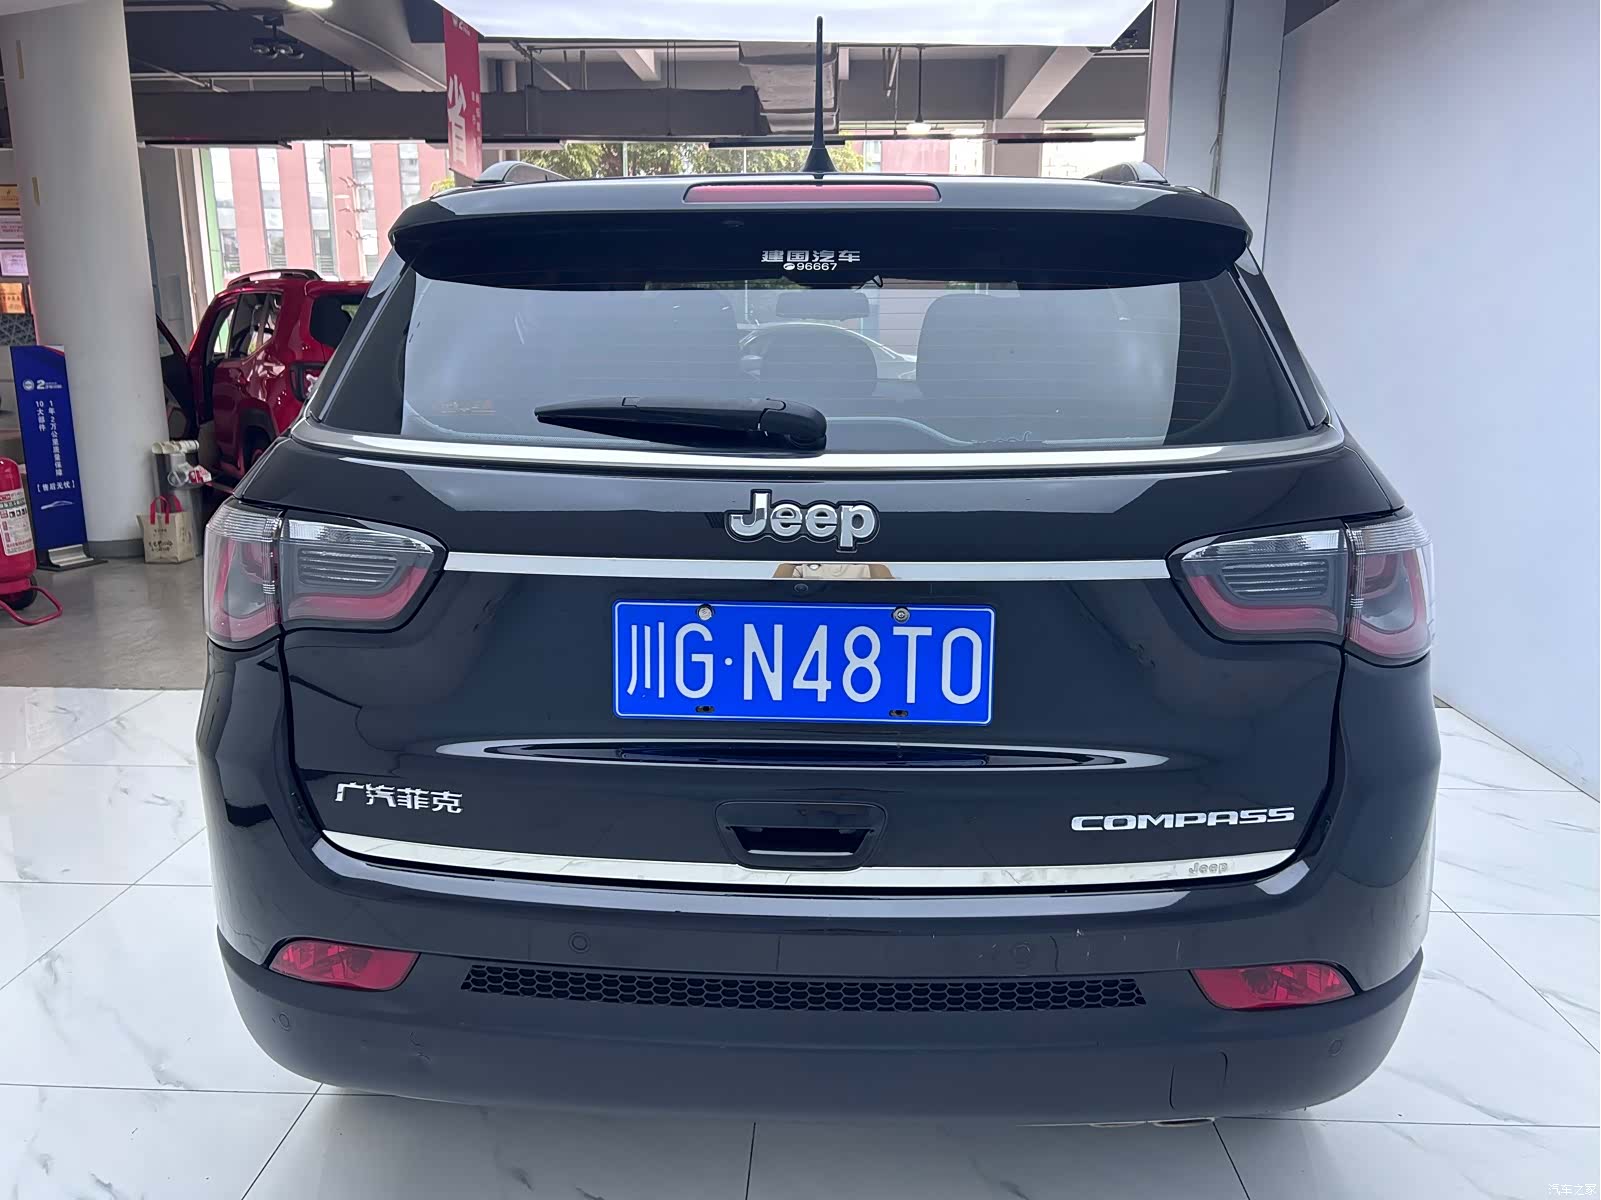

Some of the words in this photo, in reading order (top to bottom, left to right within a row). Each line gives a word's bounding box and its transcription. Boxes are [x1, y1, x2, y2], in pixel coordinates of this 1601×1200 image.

[760, 249, 861, 262] 建国汽车
[796, 262, 838, 271] 96667
[729, 491, 877, 549] Jeep
[335, 782, 463, 814] 广汽菲克
[1070, 806, 1296, 832] COMPASS
[1188, 861, 1229, 875] Jeep
